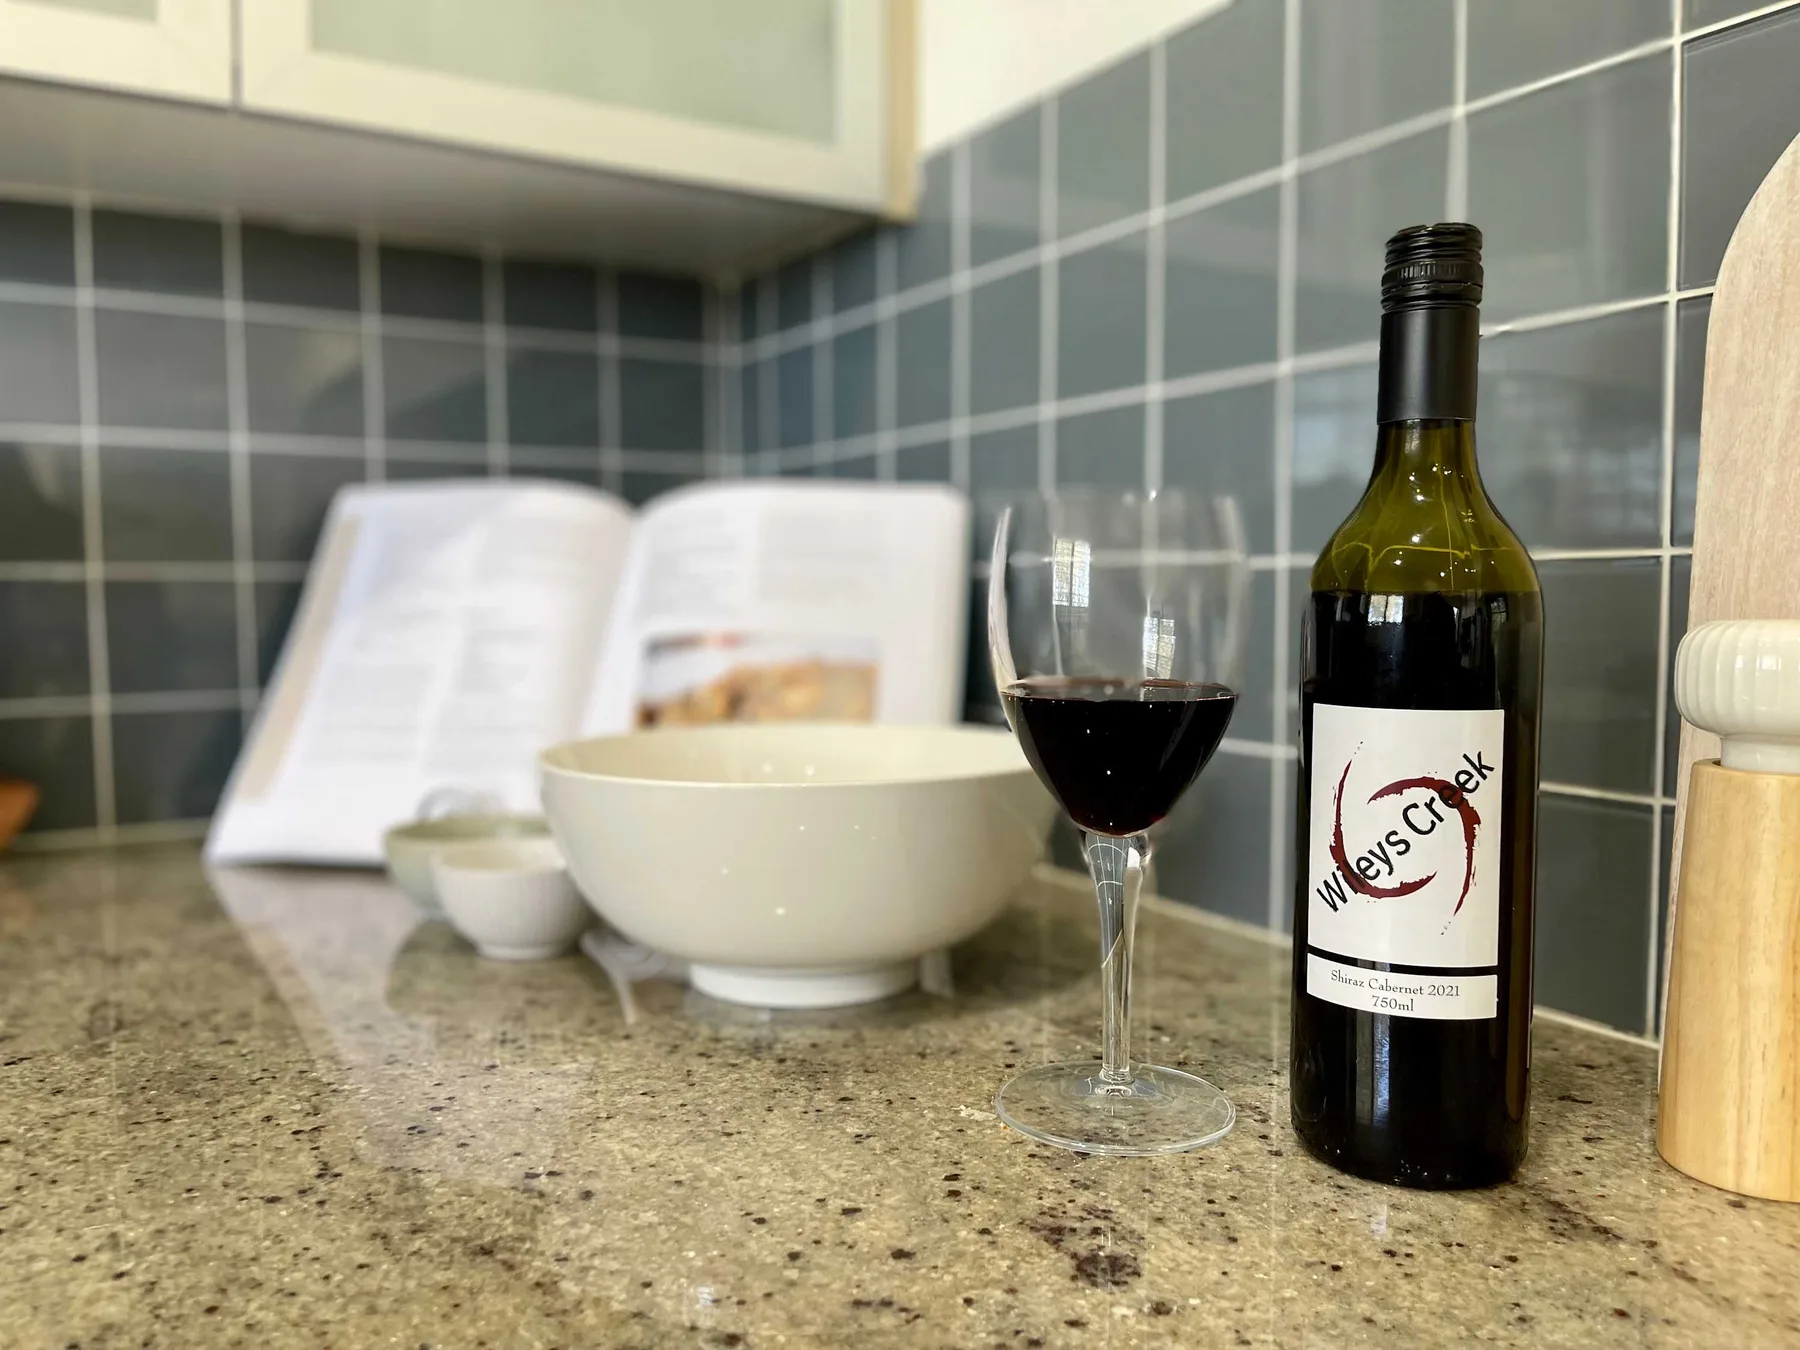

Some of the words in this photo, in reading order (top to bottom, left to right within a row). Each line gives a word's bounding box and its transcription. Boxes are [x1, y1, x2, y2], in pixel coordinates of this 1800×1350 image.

[1402, 750, 1495, 836] Creek
[1330, 969, 1365, 989] Shiraz
[1368, 977, 1424, 996] Cabernet
[1427, 984, 1460, 998] 2021
[1371, 995, 1415, 1012] 750ml
